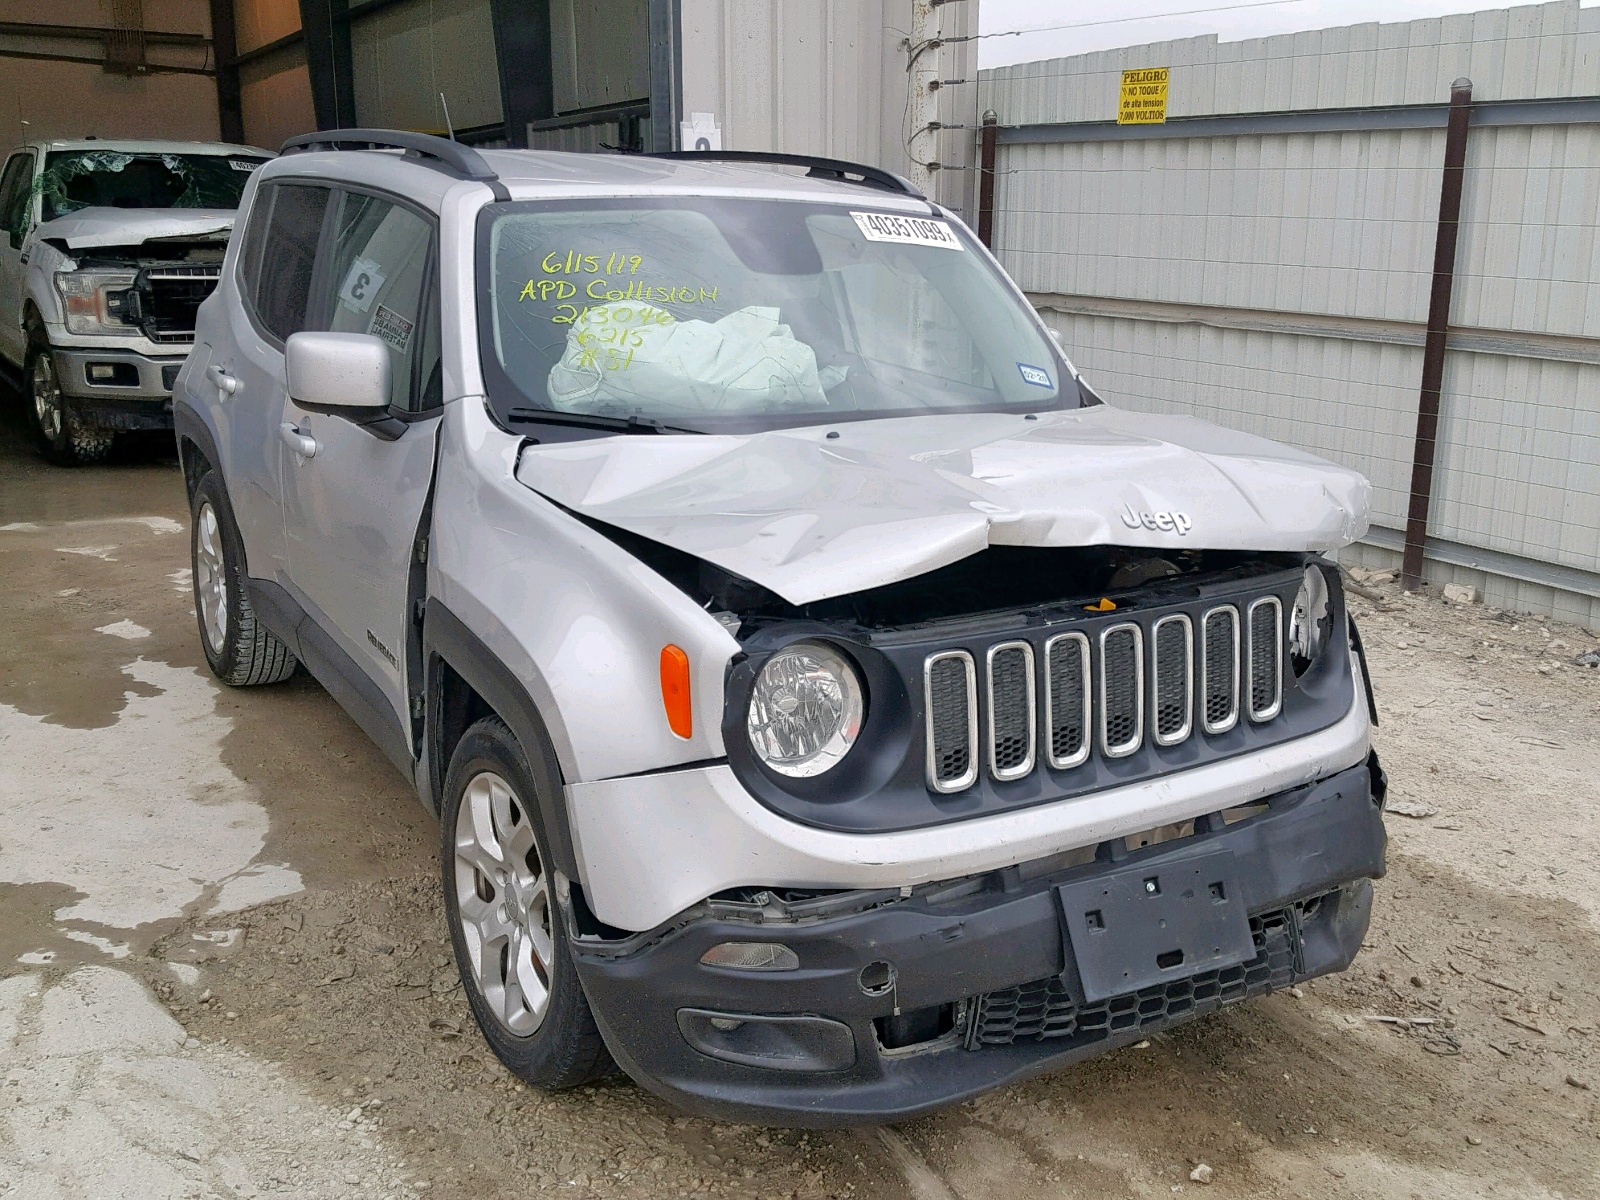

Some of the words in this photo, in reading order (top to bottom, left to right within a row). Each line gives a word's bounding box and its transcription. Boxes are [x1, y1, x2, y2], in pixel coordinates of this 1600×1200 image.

[1123, 70, 1168, 82] PELIGRO
[1128, 87, 1137, 96] NO
[1139, 86, 1159, 95] TOQUE
[1123, 100, 1130, 108] de
[1131, 99, 1141, 108] alta
[1143, 98, 1163, 108] tension
[1136, 110, 1164, 120] VOLTIOS
[866, 214, 946, 242] 40351099
[518, 279, 578, 303] APD
[577, 326, 653, 347] 6215
[1120, 502, 1192, 536] Jeep
